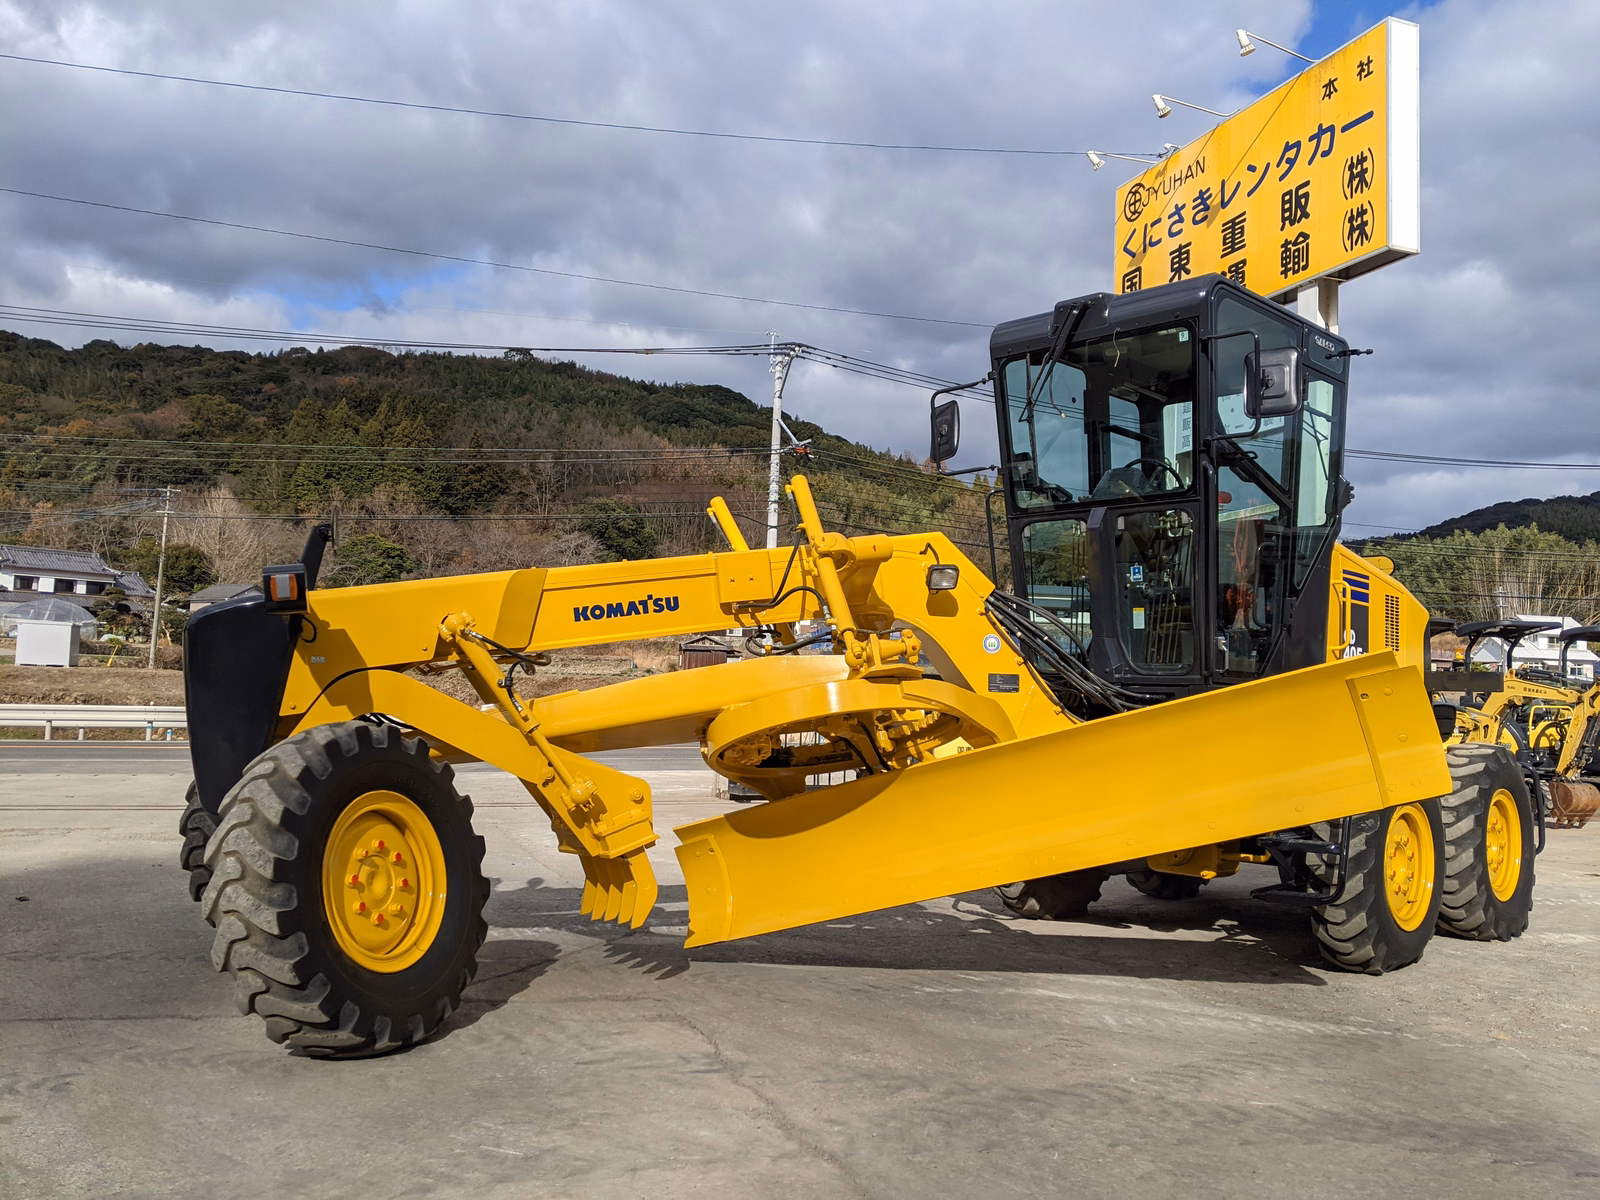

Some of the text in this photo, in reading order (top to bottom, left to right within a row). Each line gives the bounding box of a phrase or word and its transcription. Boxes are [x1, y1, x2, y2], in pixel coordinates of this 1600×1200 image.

[1321, 55, 1374, 101] 本社
[1122, 110, 1374, 258] くにさきレンタカー
[1142, 155, 1206, 208] JYUHAN
[573, 594, 680, 622] KOMATSU
